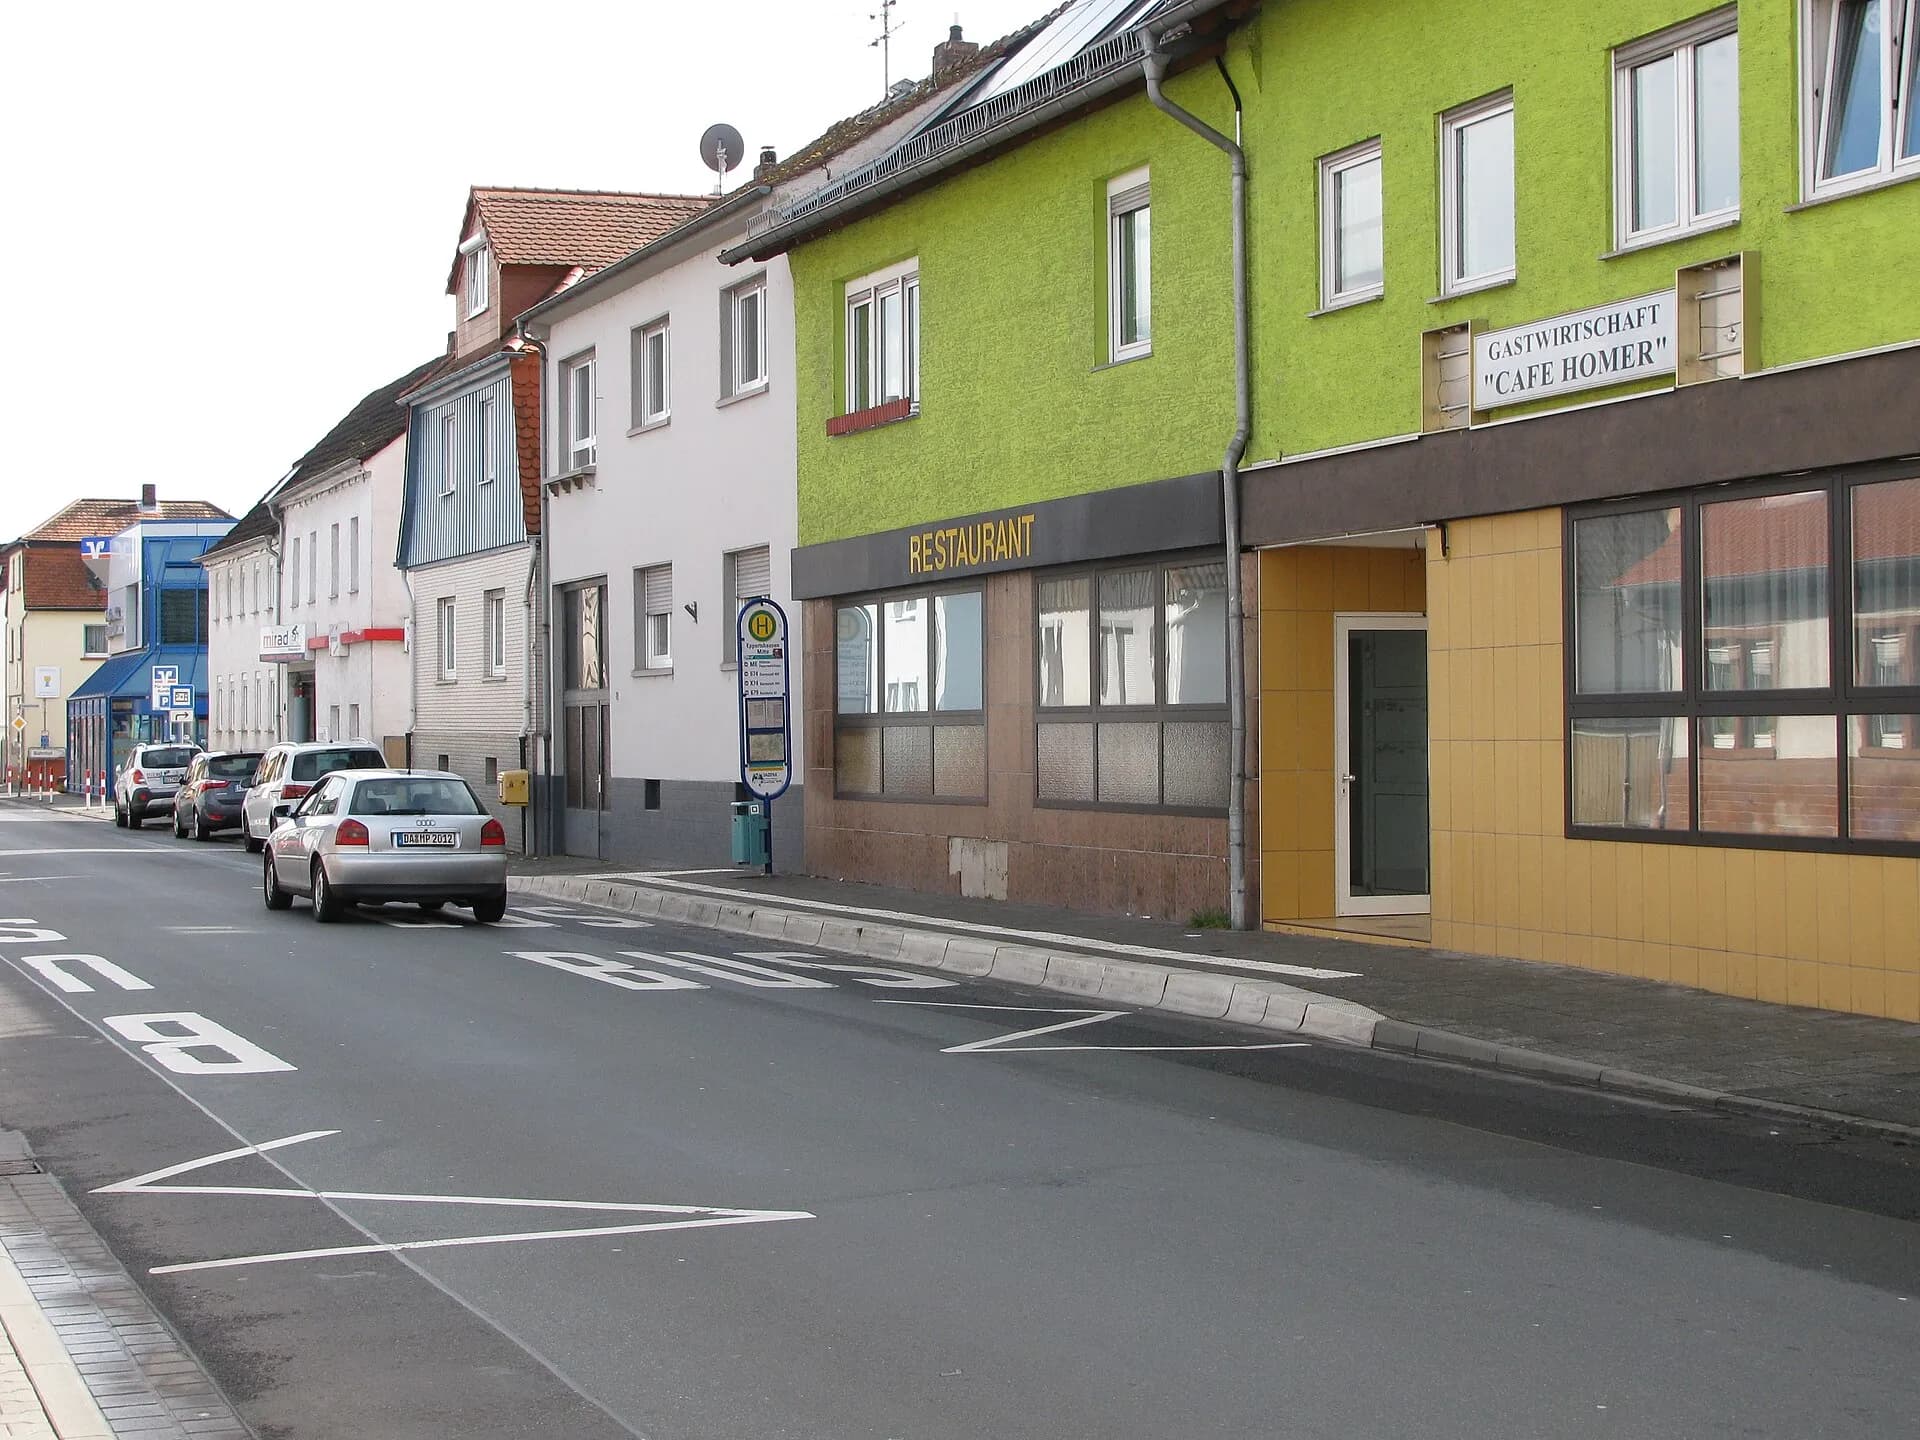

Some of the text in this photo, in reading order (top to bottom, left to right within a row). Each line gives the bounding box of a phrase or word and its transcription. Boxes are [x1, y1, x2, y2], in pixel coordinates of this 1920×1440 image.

[1488, 303, 1661, 361] GASTWIRTSCHAFT
[1483, 335, 1668, 396] "CAFE HOMER"
[909, 513, 1036, 575] RESTAURANT
[263, 631, 289, 648] mirad
[756, 616, 769, 635] H
[404, 834, 414, 844] DA
[432, 833, 453, 844] 2012
[504, 950, 961, 992] BUS
